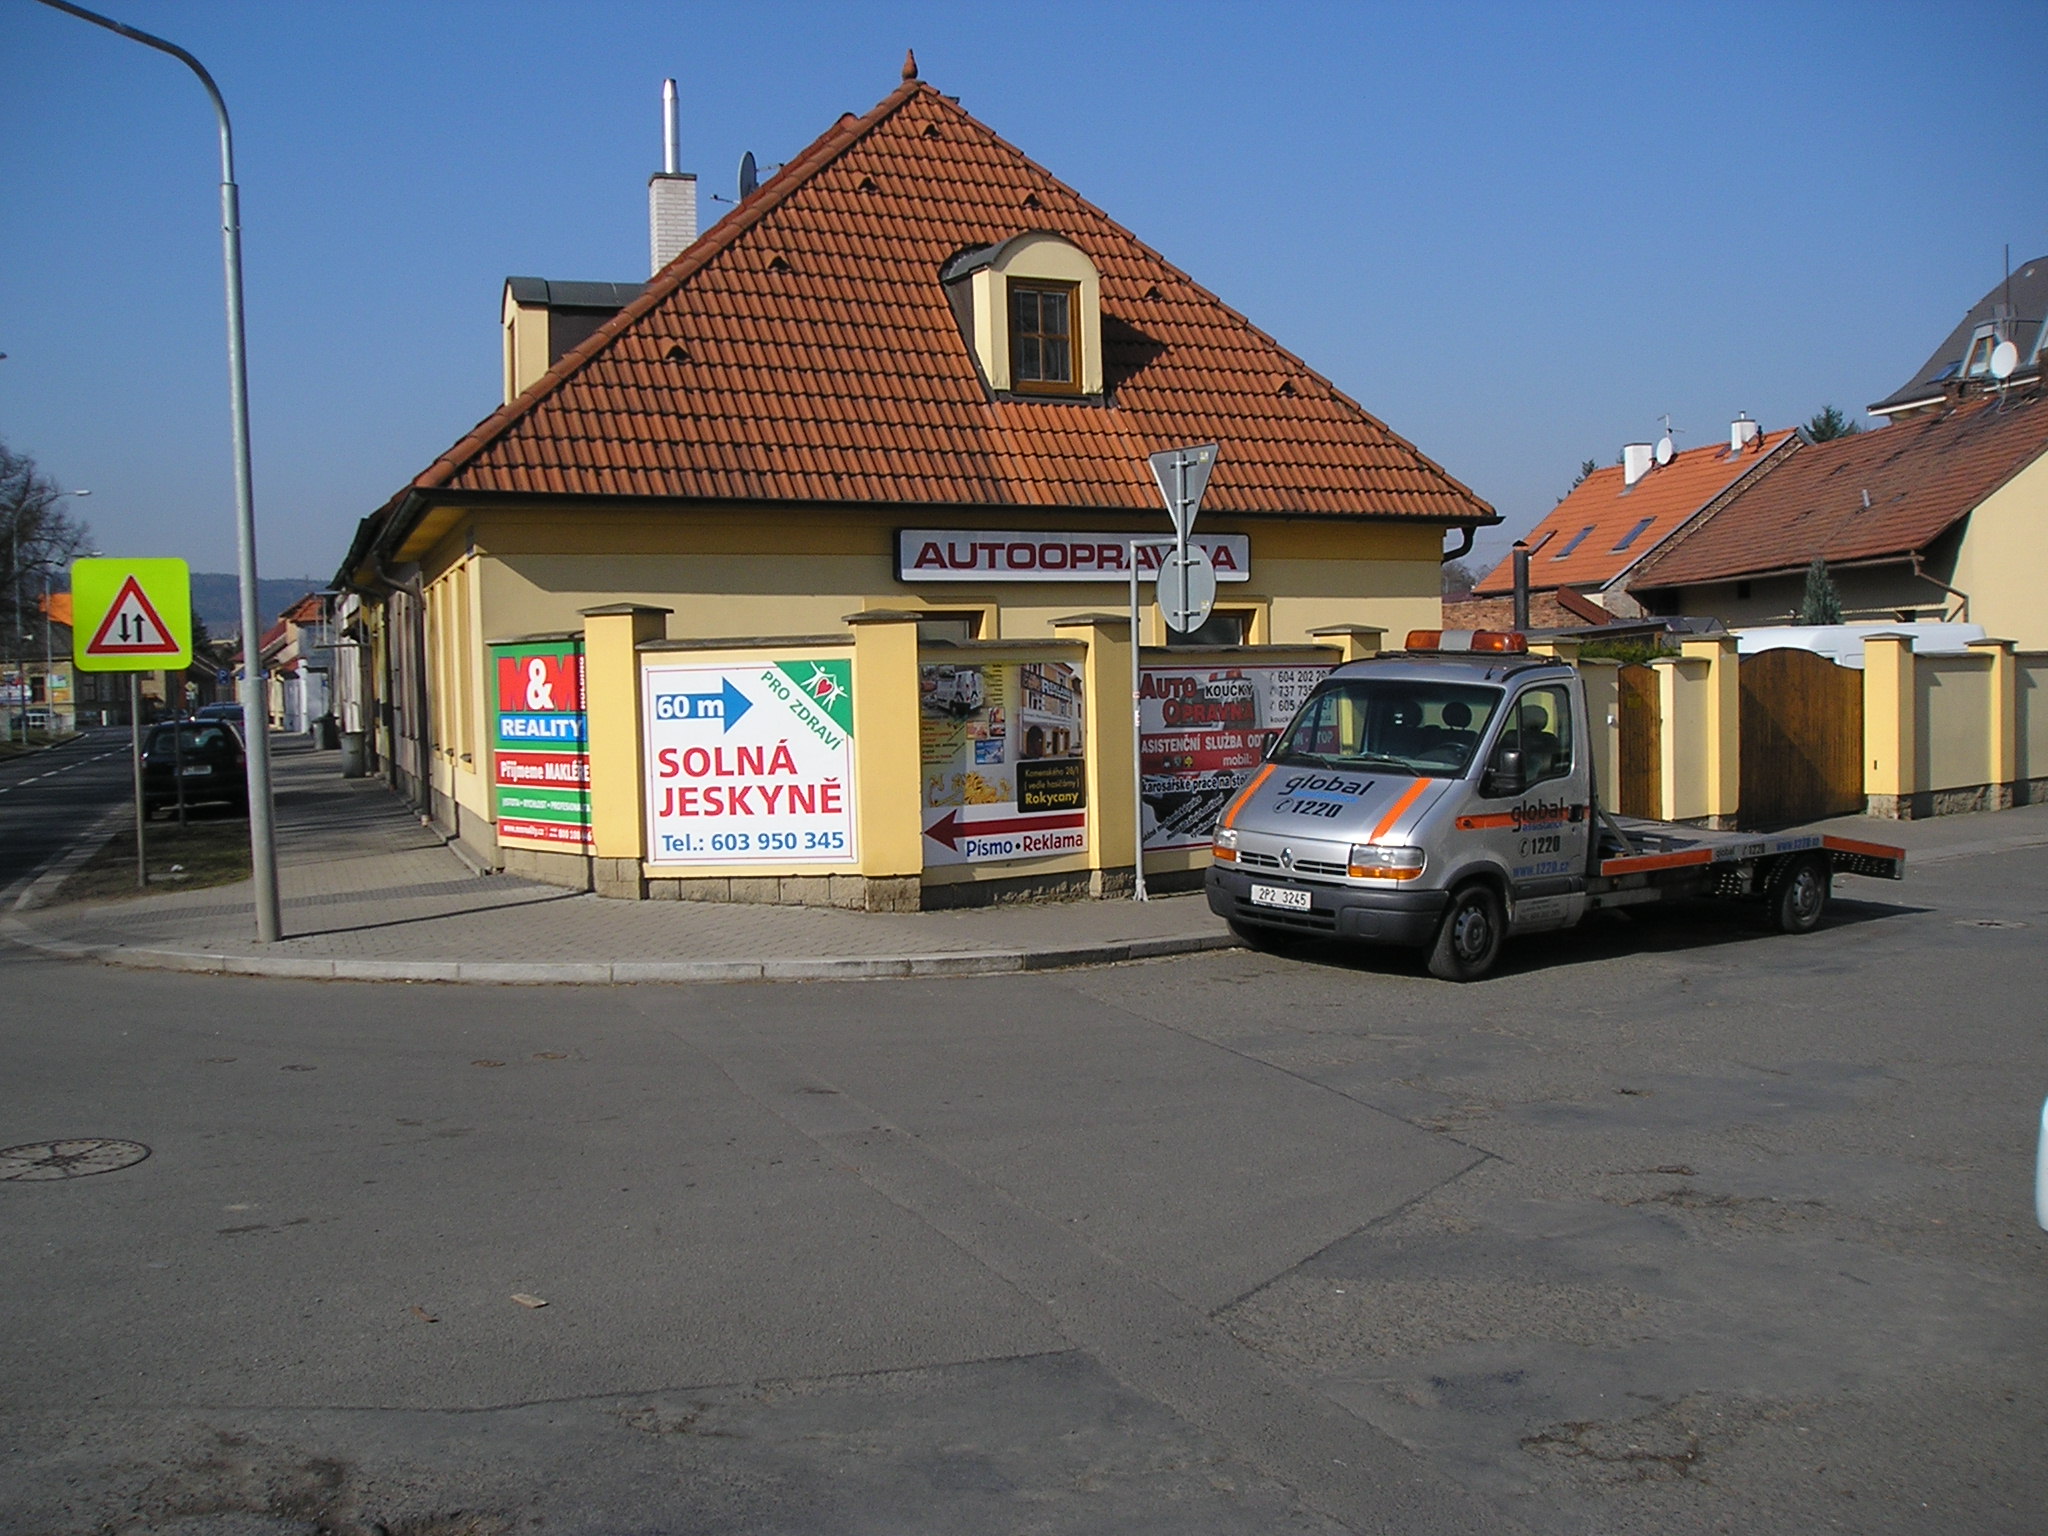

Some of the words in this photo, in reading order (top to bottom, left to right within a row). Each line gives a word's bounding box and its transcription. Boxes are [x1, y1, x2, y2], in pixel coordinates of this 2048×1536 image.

[914, 542, 1237, 570] AUTOOPRAVA
[1278, 671, 1294, 682] 604
[1298, 671, 1313, 682] 202
[1279, 685, 1295, 697] 737
[657, 695, 690, 718] 60
[697, 698, 725, 717] m
[761, 670, 790, 702] PRO
[789, 699, 844, 751] ZDRAVÍ
[1279, 700, 1295, 711] 605
[501, 718, 582, 737] REALITY
[1141, 732, 1201, 753] ASISTENČNÍ
[1205, 733, 1243, 749] SLUŽBA
[658, 739, 798, 778] SOLNÁ
[1222, 754, 1253, 766] mobil:
[1219, 774, 1232, 788] na
[1278, 774, 1375, 796] global
[659, 777, 842, 818] JESKYNĚ
[1025, 791, 1079, 806] Rokycany
[1292, 800, 1343, 818] 1220
[1511, 797, 1563, 832] global
[662, 834, 704, 851] Tel.:
[711, 834, 750, 851] 603
[758, 833, 797, 850] 950
[804, 832, 844, 849] 345
[966, 839, 1013, 857] Písmo
[1023, 833, 1083, 852] Reklama
[1531, 835, 1560, 855] 1220
[1512, 862, 1569, 877] www.1220.cz
[1258, 887, 1276, 901] 2P2
[1282, 891, 1306, 906] 3245
